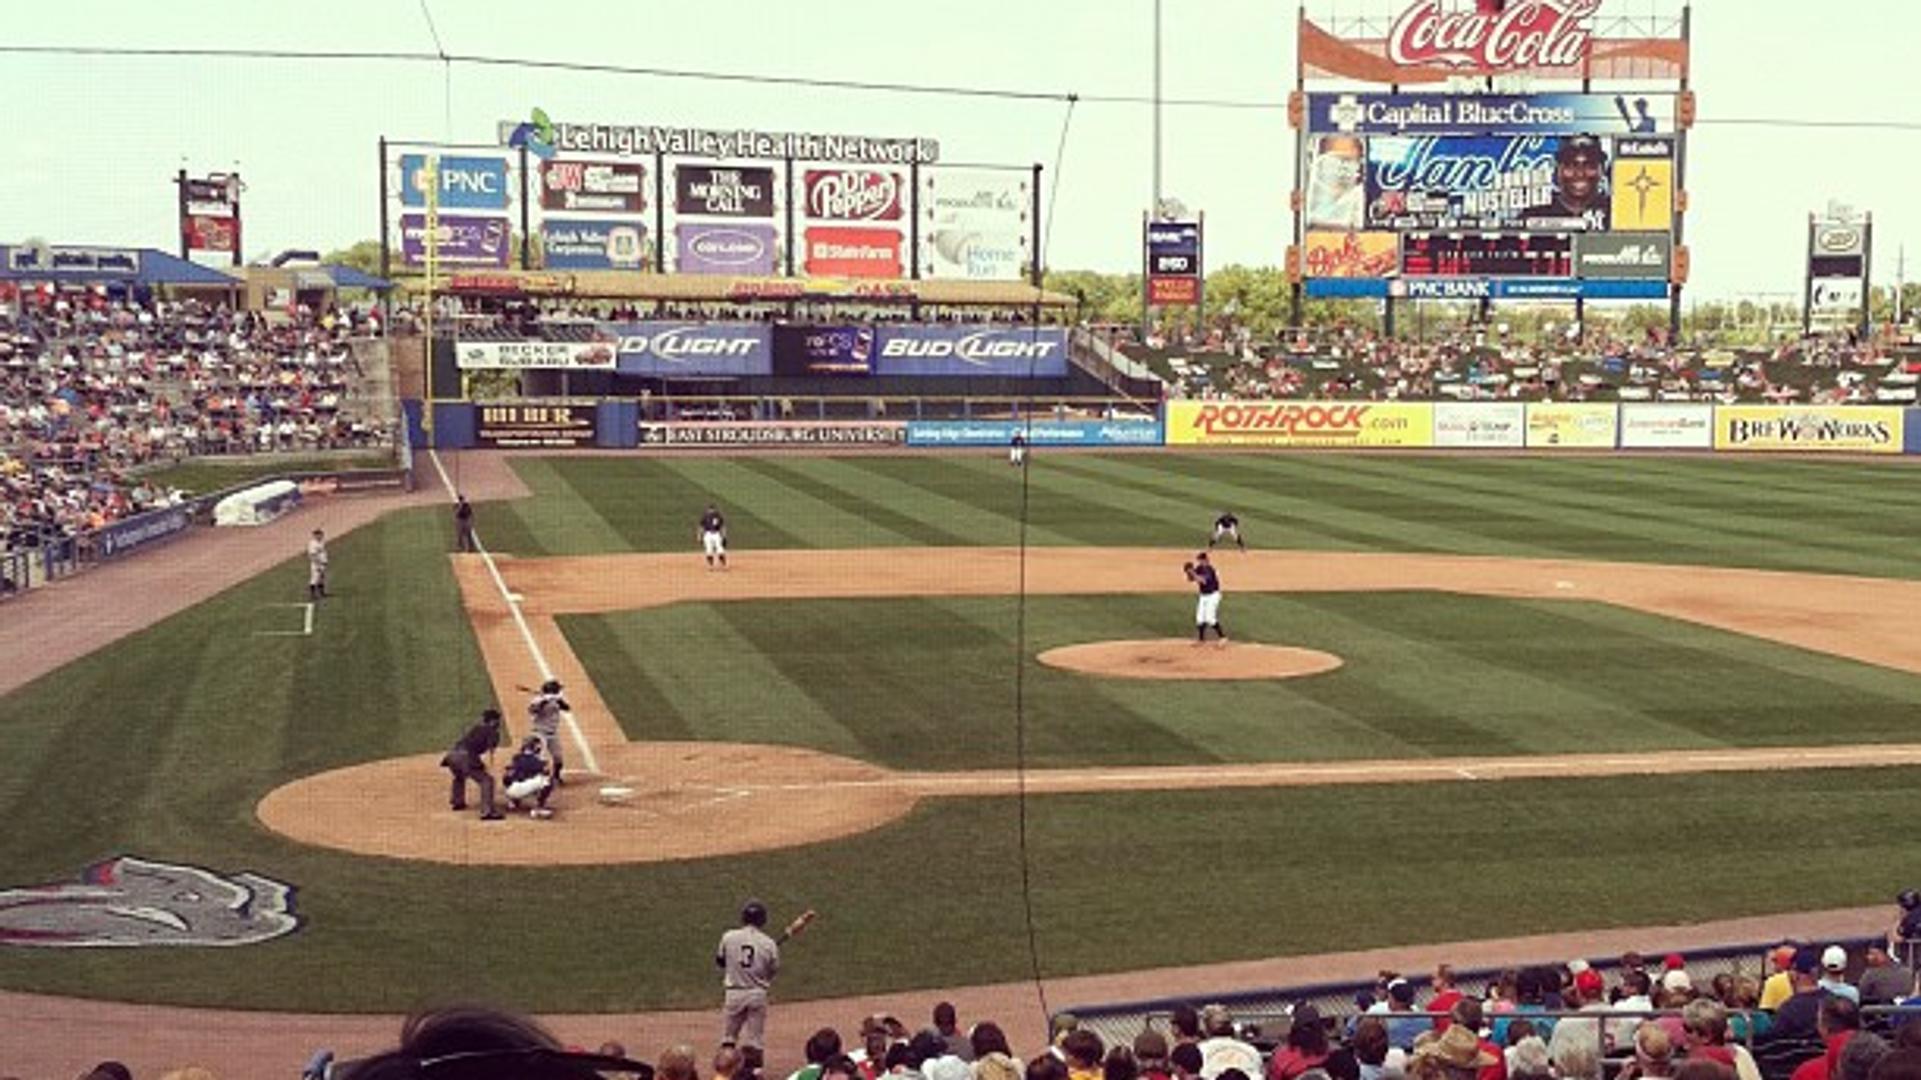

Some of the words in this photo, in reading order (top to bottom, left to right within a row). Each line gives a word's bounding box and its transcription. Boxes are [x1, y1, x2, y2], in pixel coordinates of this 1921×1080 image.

[1389, 0, 1600, 67] Coca-Cola
[1367, 102, 1451, 130] Capital
[1456, 101, 1575, 125] BlueCross
[560, 123, 649, 157] Lehigh
[653, 127, 736, 160] Valley
[737, 131, 819, 159] Health
[824, 136, 932, 163] Network
[442, 171, 497, 193] PNC
[709, 170, 742, 183] THE
[841, 172, 872, 193] Dr
[689, 182, 762, 199] MORNING
[812, 175, 888, 219] Pepper
[706, 198, 745, 213] CALL
[967, 245, 1015, 261] Home
[664, 338, 761, 355] LIGHT
[882, 339, 952, 357] BUD
[967, 340, 1058, 358] LIGHT
[1193, 405, 1373, 436] ROTHROCK
[666, 427, 703, 443] EAST
[705, 427, 816, 443] STROUDSBURG
[818, 428, 906, 443] UNIVERSITY
[740, 945, 755, 968] 3
